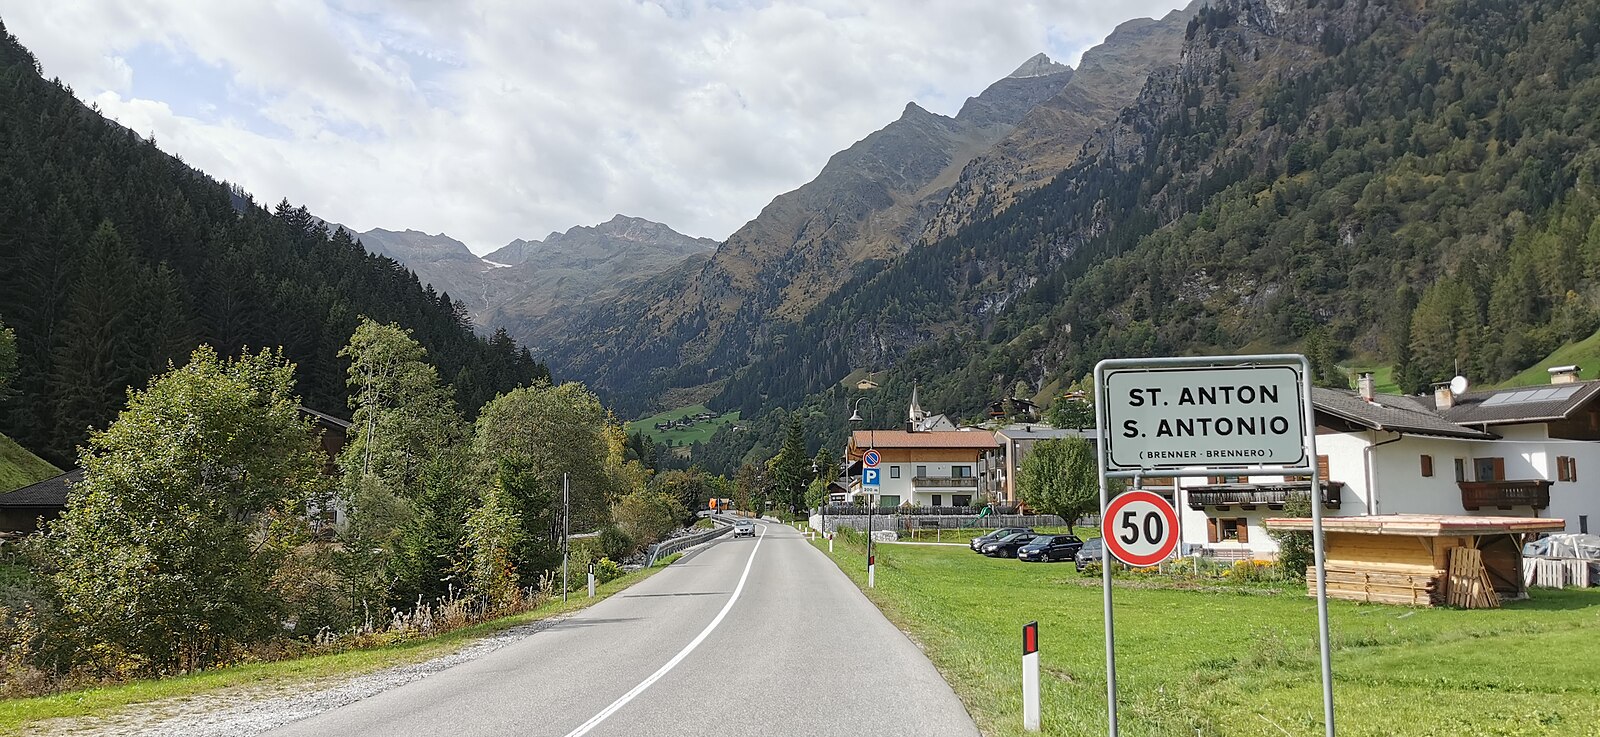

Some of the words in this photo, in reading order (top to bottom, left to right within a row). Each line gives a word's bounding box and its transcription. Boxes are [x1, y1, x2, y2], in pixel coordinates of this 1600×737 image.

[1129, 388, 1168, 407] ST.
[1178, 385, 1278, 406] ANTON
[1123, 419, 1146, 438] S.
[1156, 416, 1289, 437] ANTONIO
[1147, 450, 1197, 459] BRENNER
[1206, 449, 1265, 458] BRENNERO
[866, 470, 877, 483] P
[1120, 511, 1163, 545] 50
